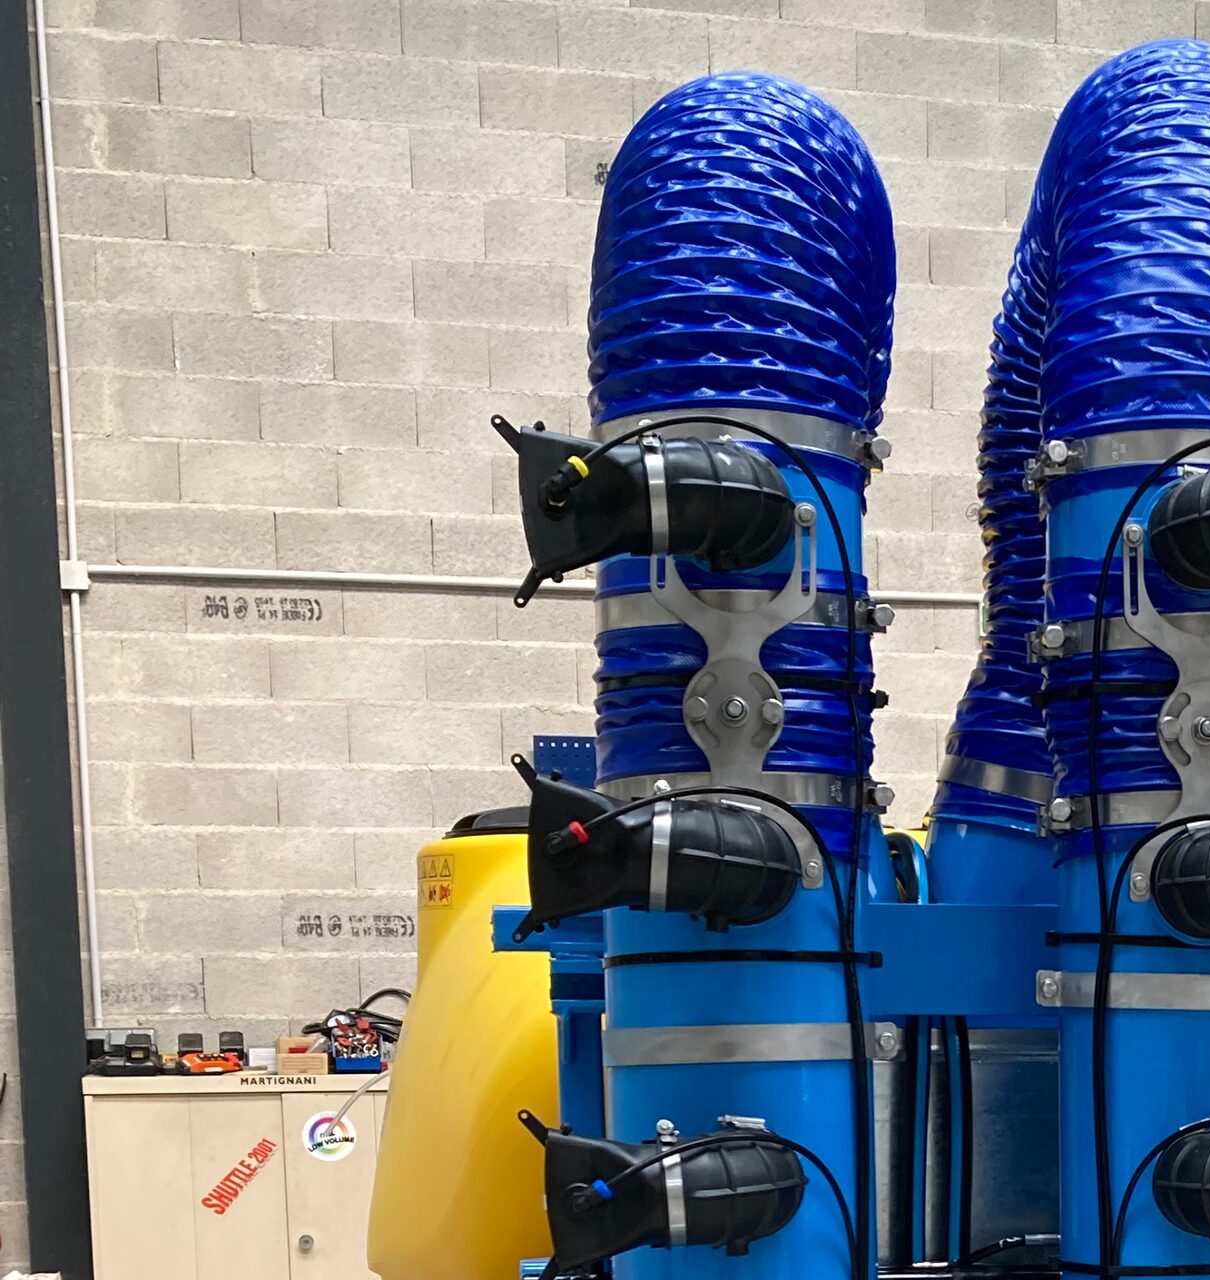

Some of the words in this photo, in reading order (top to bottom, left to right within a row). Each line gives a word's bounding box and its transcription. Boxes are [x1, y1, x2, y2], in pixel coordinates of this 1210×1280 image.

[240, 1077, 317, 1086] MARTIGNANI
[308, 1141, 323, 1152] LOW
[324, 1136, 355, 1145] VOLUME
[200, 1160, 259, 1216] SHUTTLE
[247, 1138, 277, 1166] 2001
